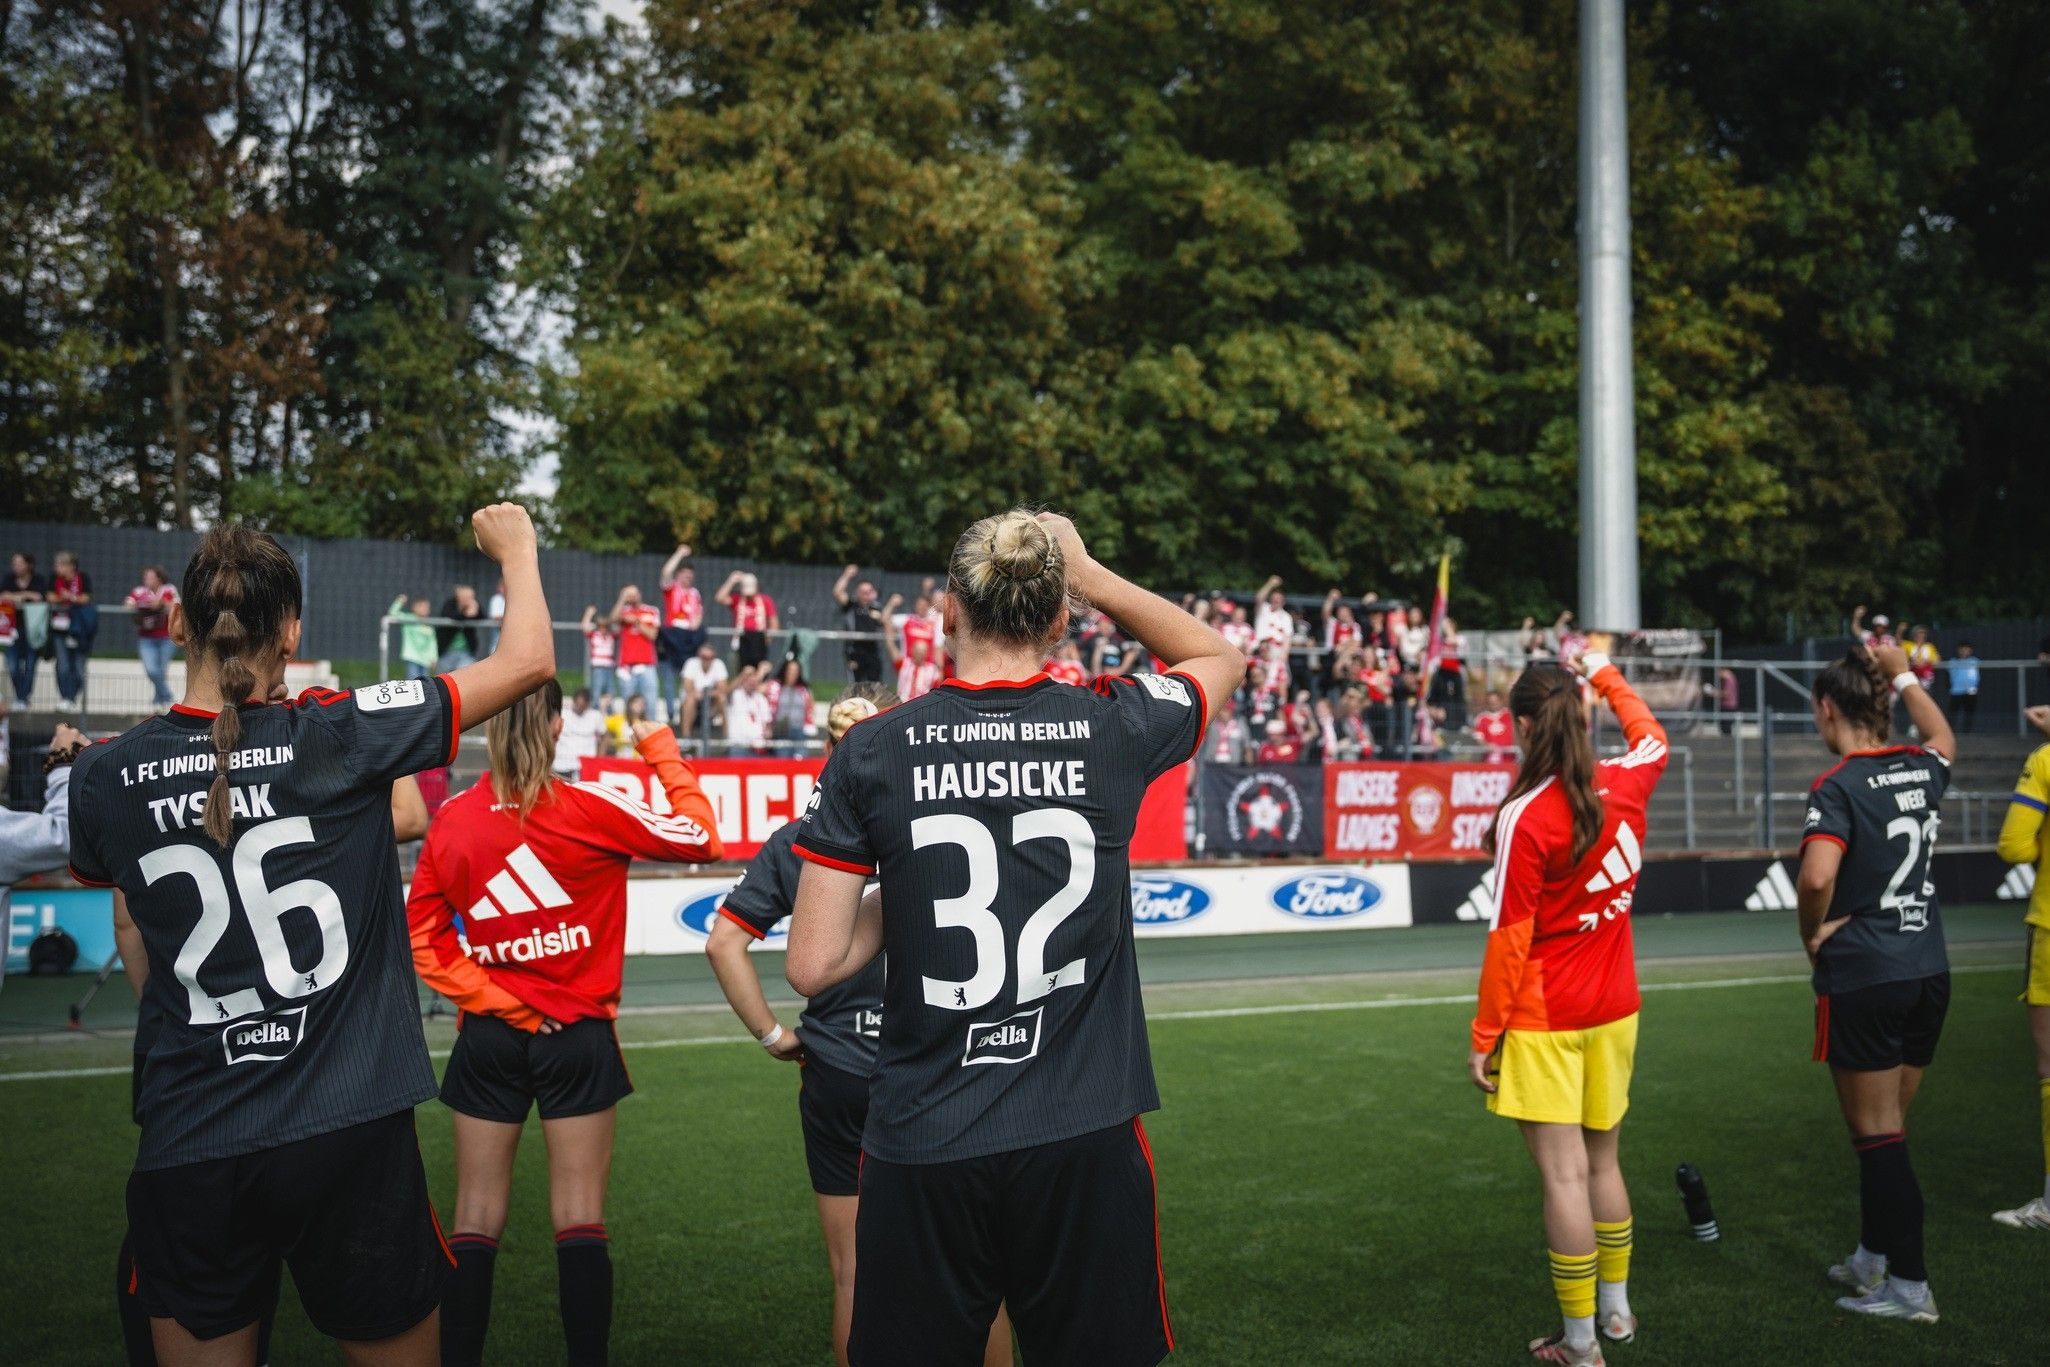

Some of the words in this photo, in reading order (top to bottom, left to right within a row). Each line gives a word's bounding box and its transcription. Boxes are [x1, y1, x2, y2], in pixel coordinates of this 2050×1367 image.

[906, 726, 921, 746] 1.
[926, 724, 948, 743] FC
[953, 722, 1015, 742] UNION
[1021, 720, 1091, 741] BERLIN
[121, 767, 134, 787] 1.
[138, 761, 158, 783] FC
[163, 753, 217, 777] UNION
[229, 744, 294, 770] BERLIN
[913, 760, 1087, 802] HAUSICKE
[148, 783, 277, 833] TYSAK
[911, 808, 1096, 1011] 32
[1290, 876, 1365, 915] Ford
[138, 816, 349, 1025] 26
[495, 921, 592, 963] raisin
